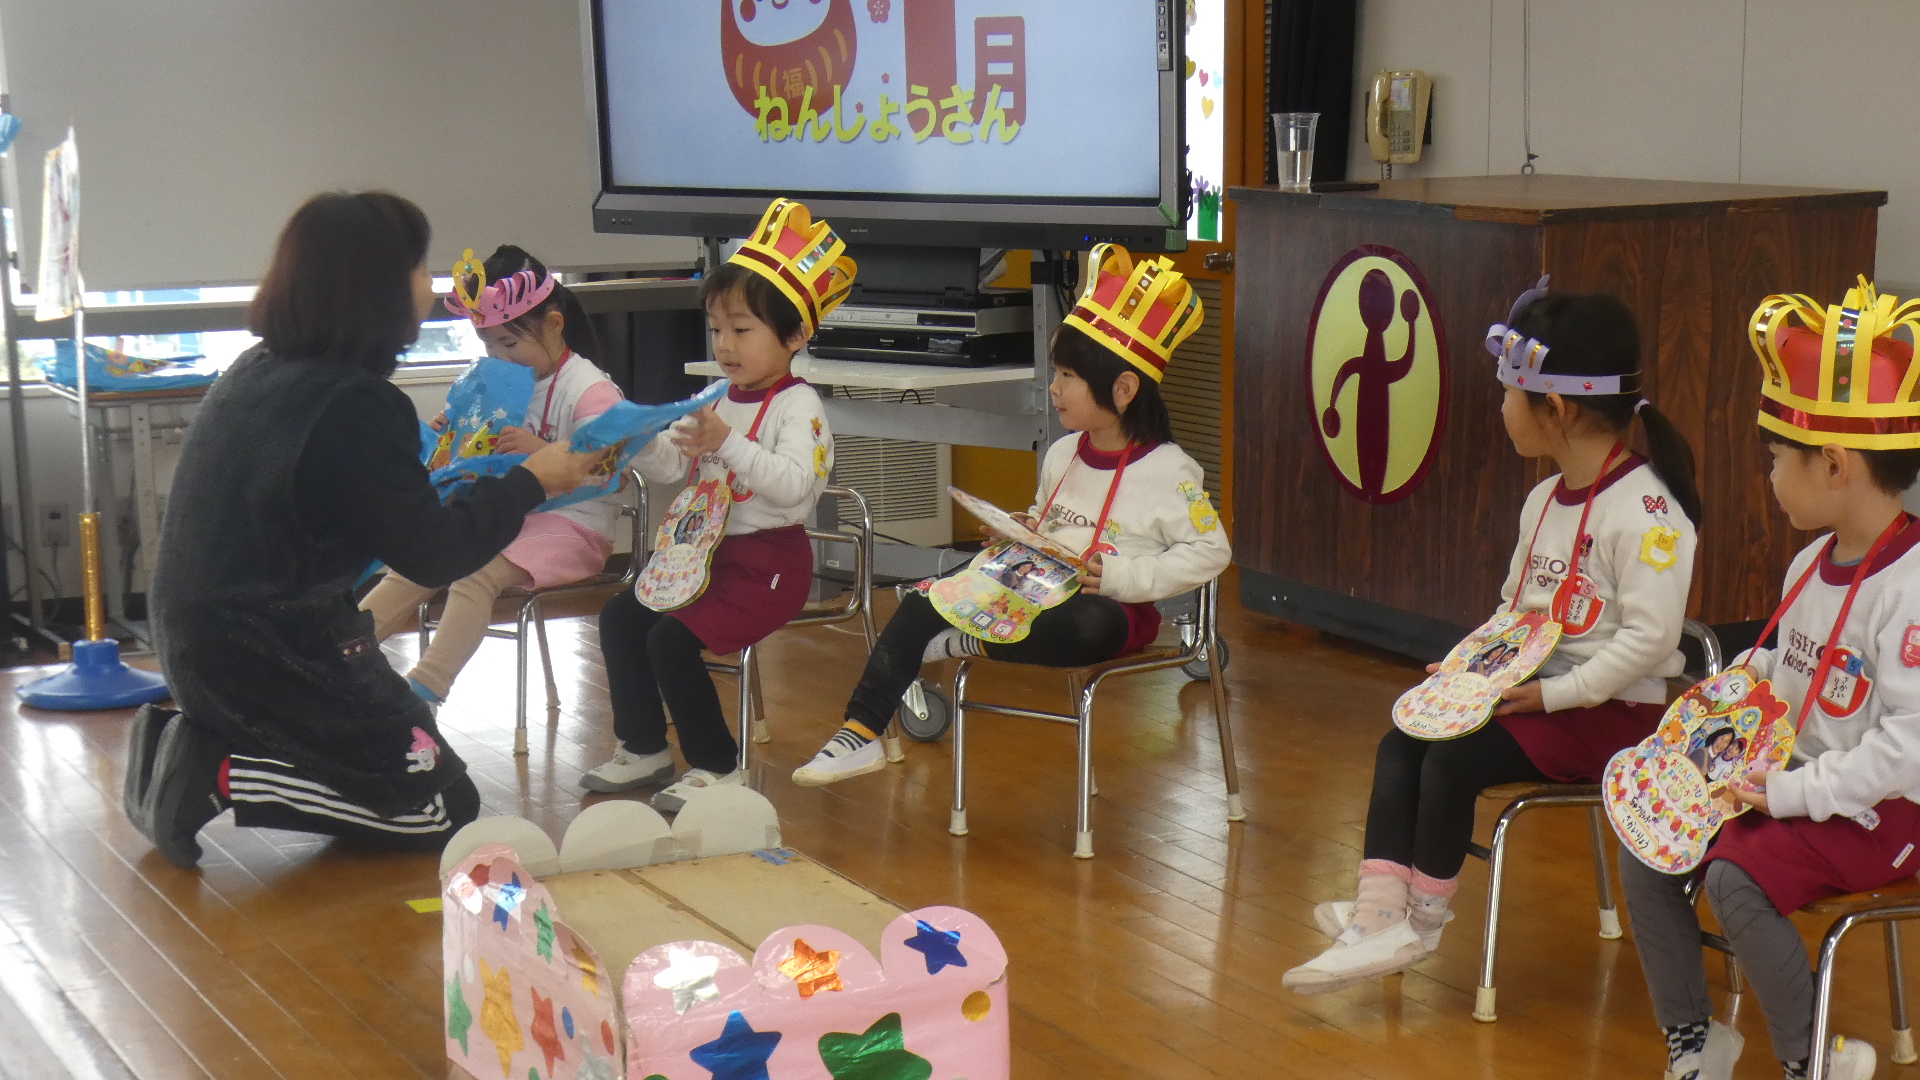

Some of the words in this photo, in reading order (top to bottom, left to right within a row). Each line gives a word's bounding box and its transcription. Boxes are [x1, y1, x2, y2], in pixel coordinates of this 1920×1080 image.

[782, 67, 806, 98] 福
[754, 84, 1021, 144] ねんしょうさん
[1583, 583, 1595, 595] 5
[1848, 660, 1858, 672] 5
[1729, 682, 1741, 697] 4
[1670, 758, 1704, 799] おたんじょうび
